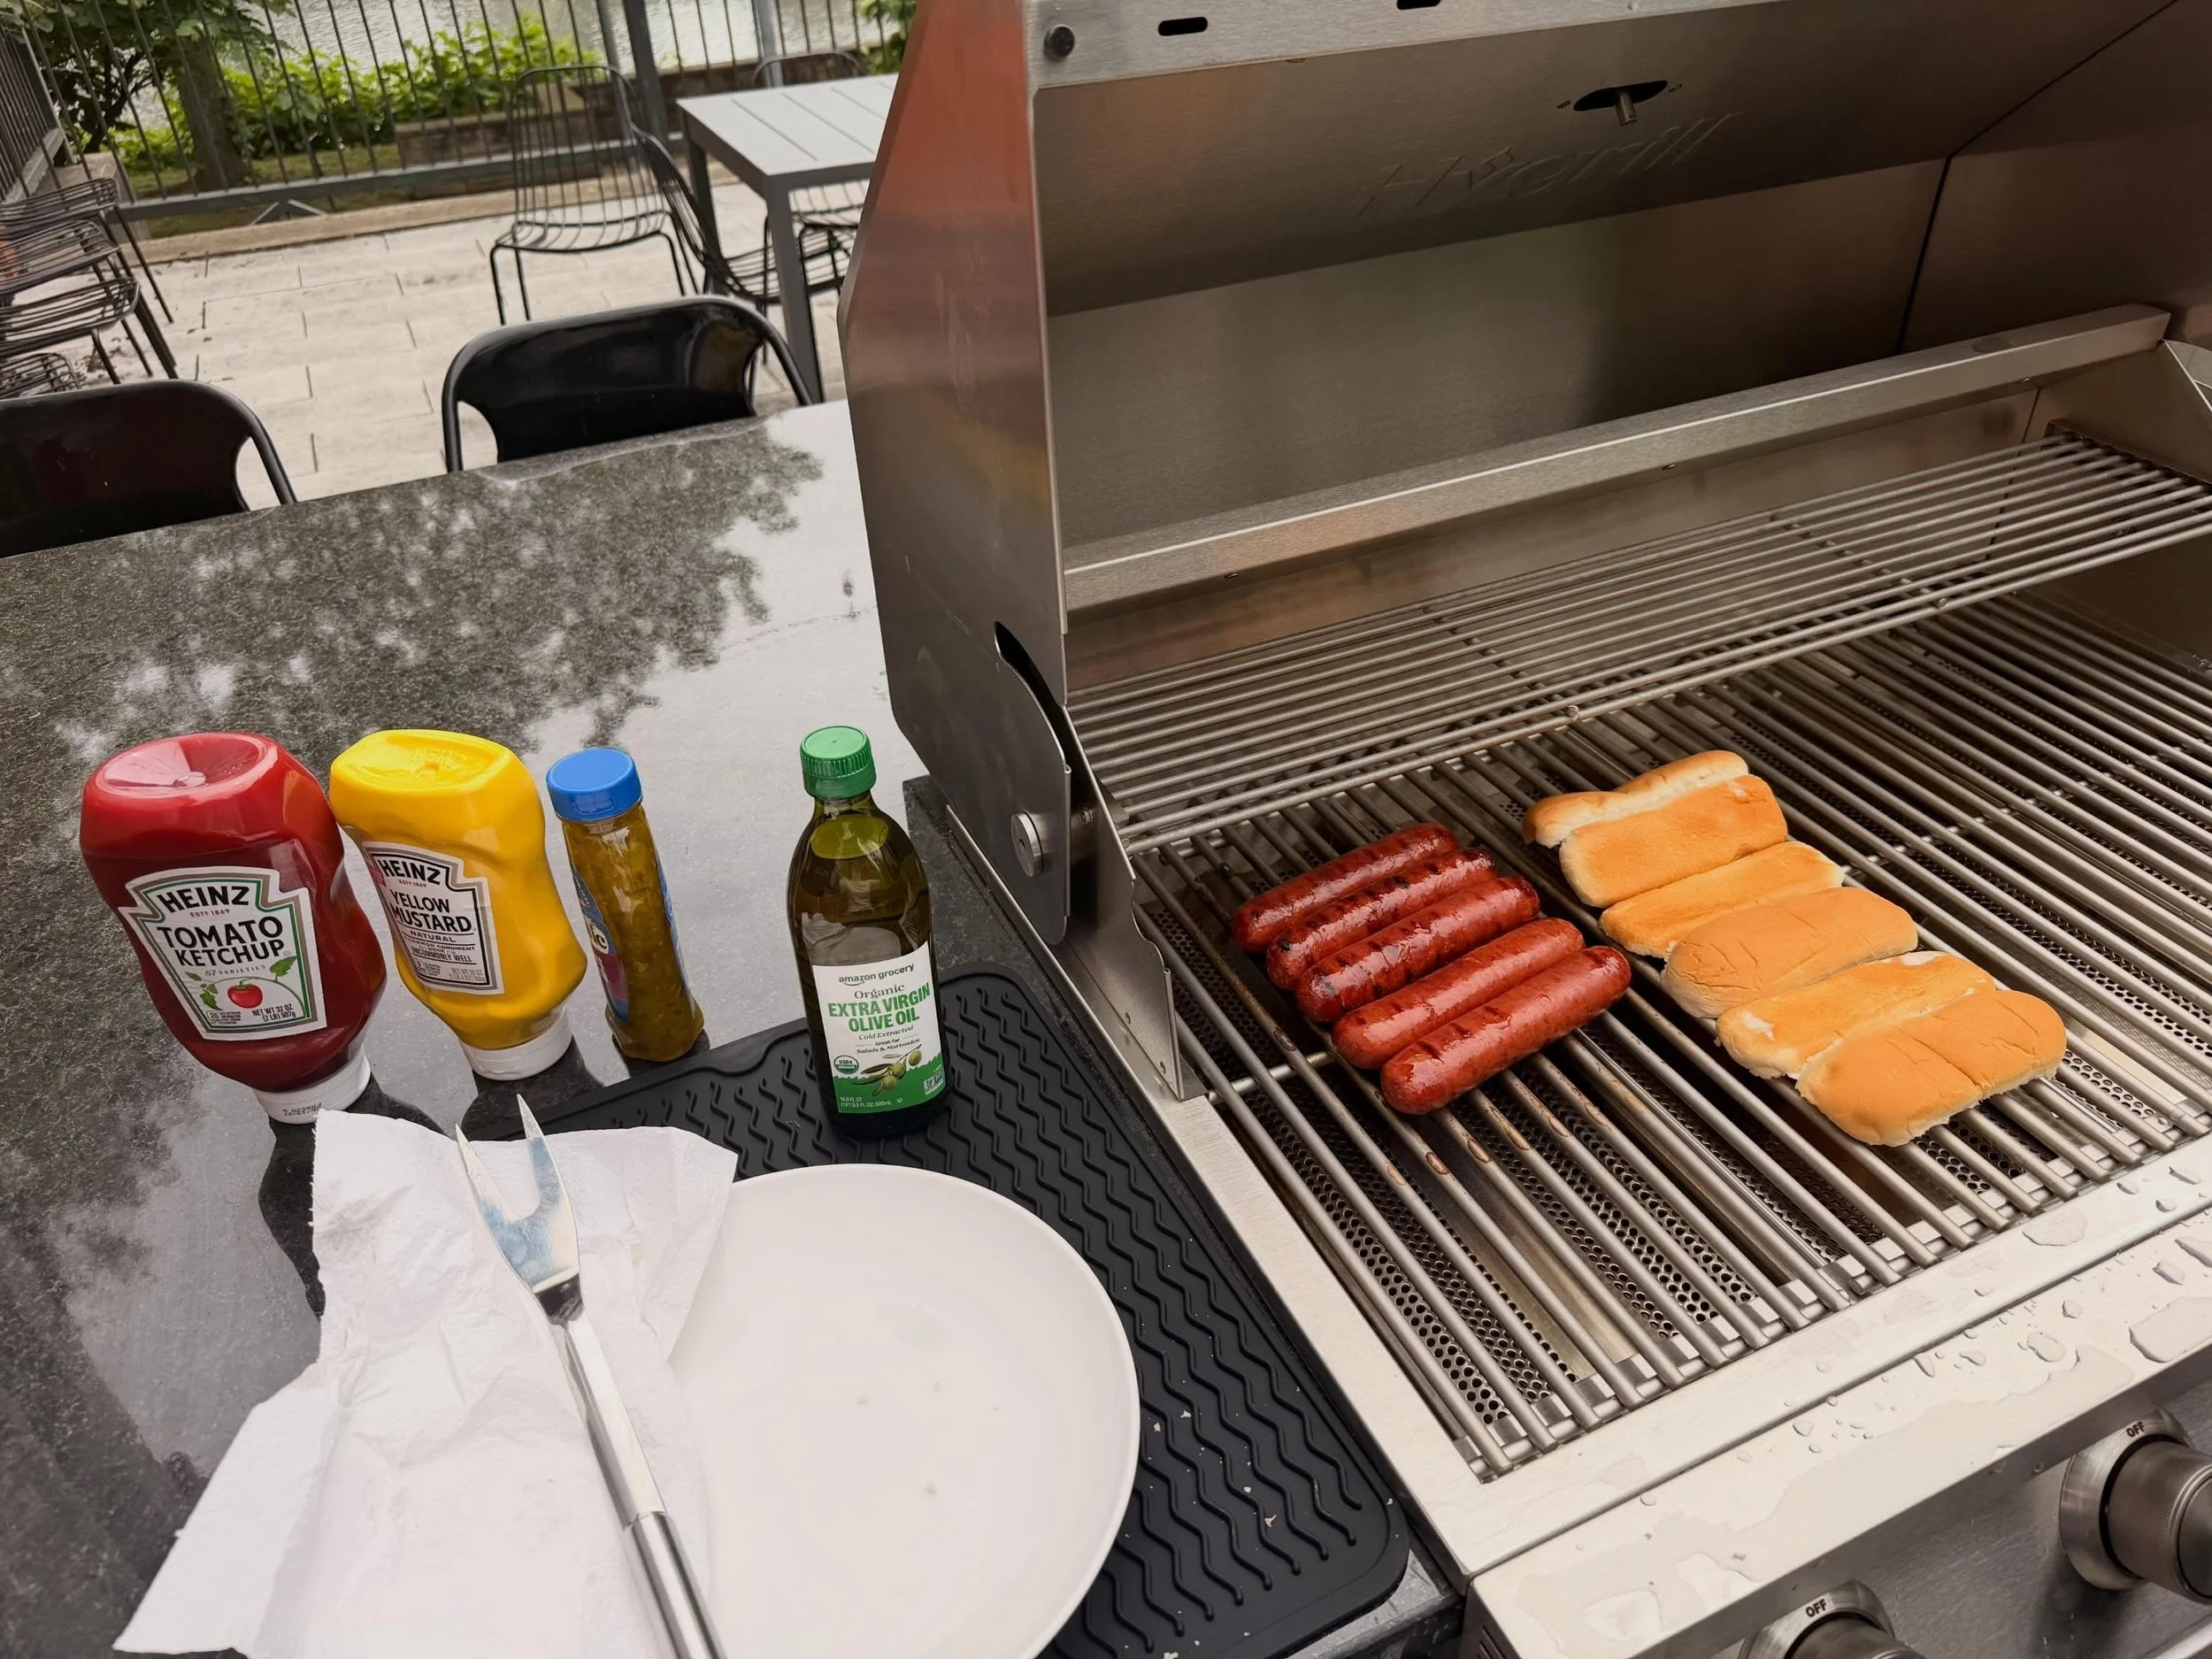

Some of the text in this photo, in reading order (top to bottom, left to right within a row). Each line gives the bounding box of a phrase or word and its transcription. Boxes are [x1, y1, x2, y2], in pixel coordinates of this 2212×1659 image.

[378, 859, 441, 885] HEINZ
[157, 886, 250, 912] HEINZ
[390, 889, 450, 913] YELLOW
[390, 903, 472, 933] MUSTARD
[156, 916, 283, 949] TOMATO
[411, 930, 457, 942] NATURAL
[173, 939, 285, 967] KETCHUP
[411, 946, 451, 961] UNCOMMONLY
[218, 964, 266, 975] VARIETIES
[839, 964, 915, 984] amazon grocery
[827, 982, 931, 1018] EXTRA VIRGIN
[854, 984, 905, 999] Organic
[849, 1007, 920, 1033] OLIVE OIL
[877, 1025, 914, 1039] Extracted
[887, 1038, 920, 1050] Marinades
[2126, 1421, 2145, 1438] OFF
[1806, 1598, 1827, 1617] OFF
